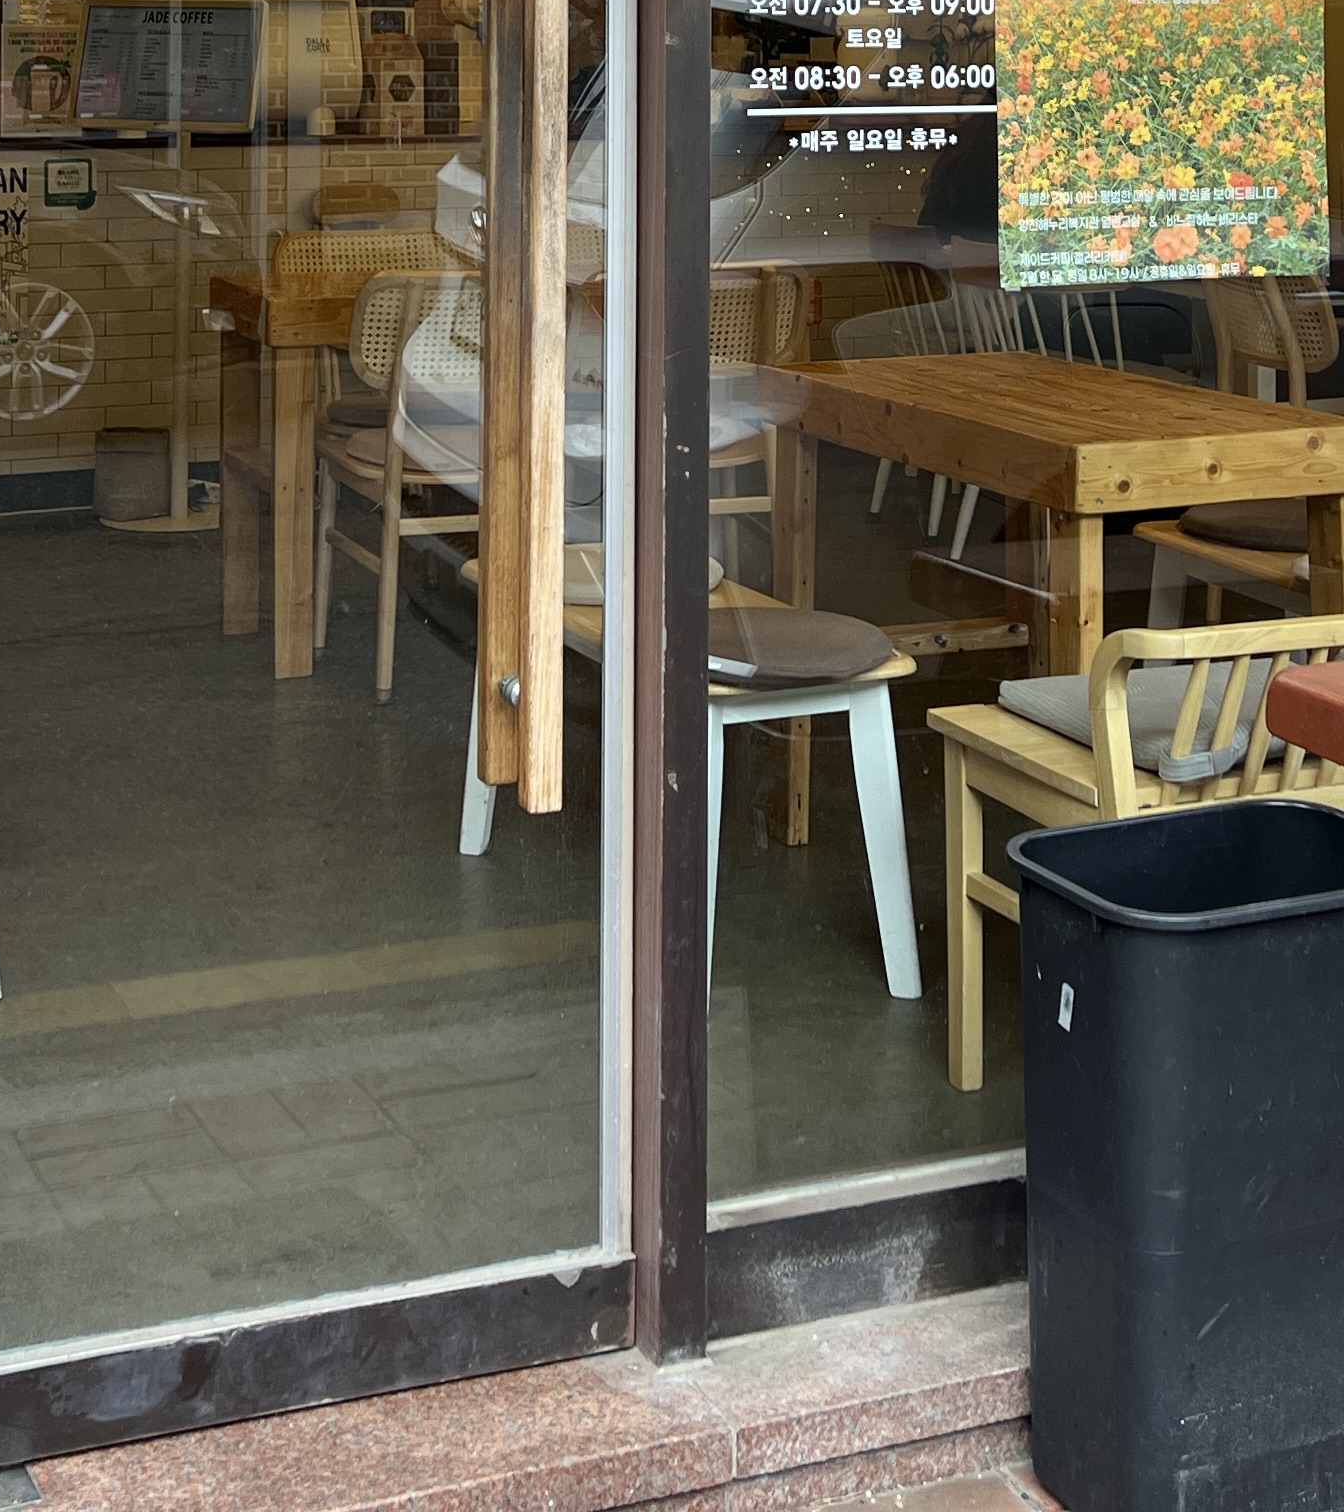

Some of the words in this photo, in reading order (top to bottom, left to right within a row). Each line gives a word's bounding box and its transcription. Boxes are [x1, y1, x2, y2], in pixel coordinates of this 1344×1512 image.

[142, 11, 170, 24] JADE
[172, 11, 214, 25] COFFEE
[845, 27, 902, 49] 토요일
[749, 66, 788, 90] 오전
[794, 65, 861, 90] 08:30
[887, 64, 925, 89] 오후
[930, 65, 996, 89] 06:00
[846, 128, 903, 151] 일요일
